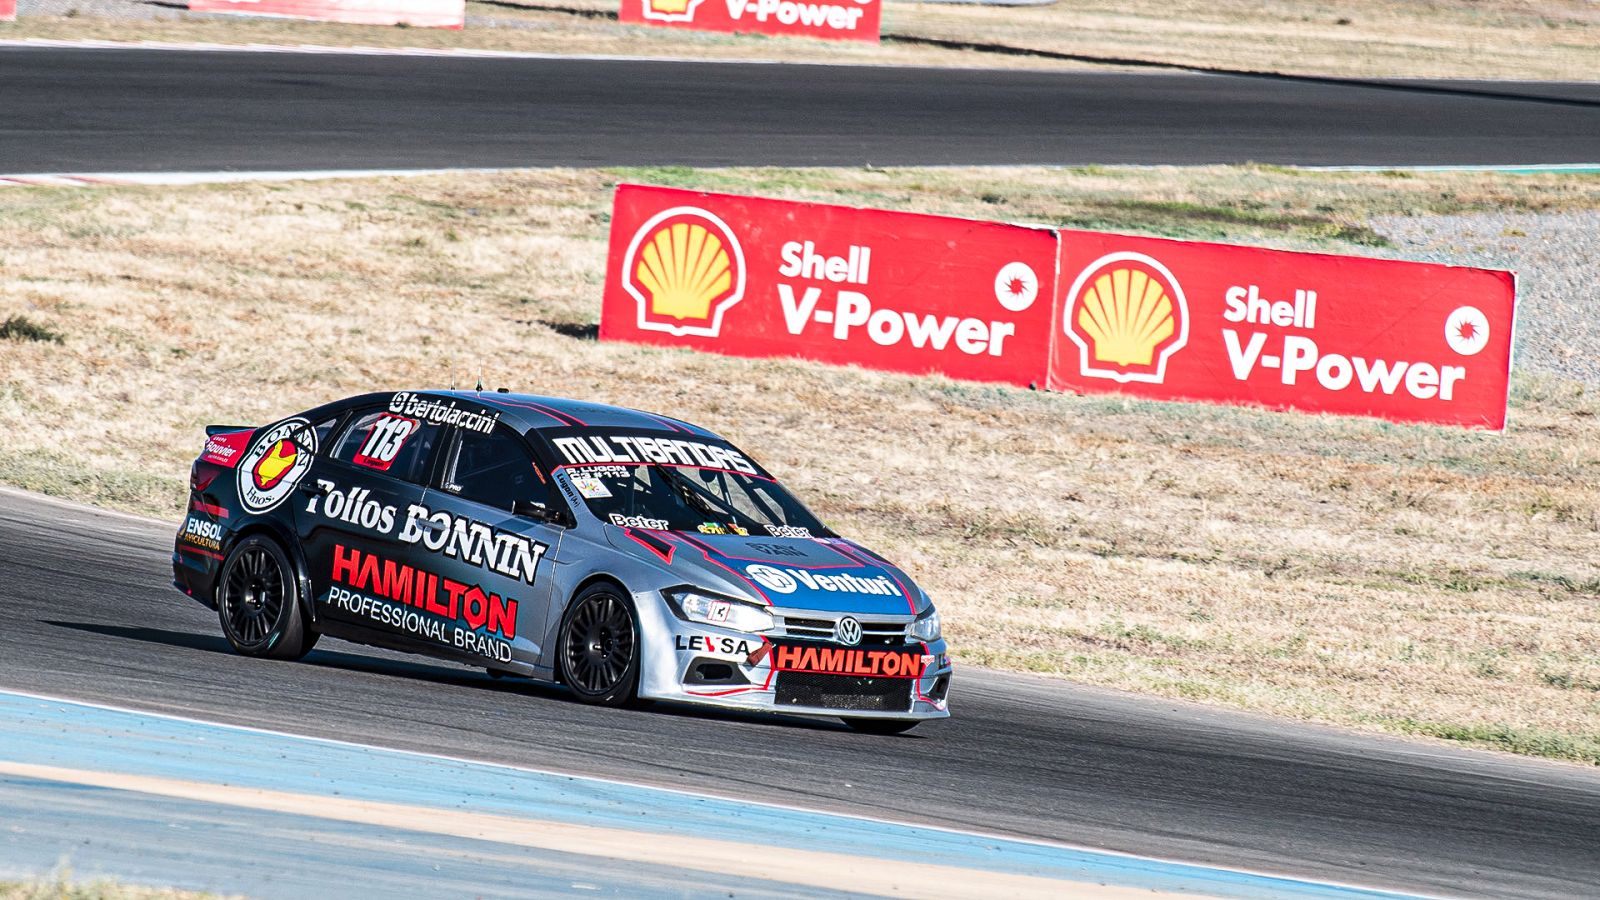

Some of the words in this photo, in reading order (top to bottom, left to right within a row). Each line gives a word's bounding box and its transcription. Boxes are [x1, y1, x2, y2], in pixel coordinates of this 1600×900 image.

[725, 0, 864, 30] V-Power
[778, 240, 871, 285] Shell
[777, 283, 1015, 357] V-Power
[1223, 285, 1318, 329] Shell
[1222, 329, 1466, 401] V-Power
[404, 393, 500, 435] bertolaccini
[361, 416, 412, 462] 113
[552, 436, 758, 475] MULTIBANDAS
[186, 517, 222, 541] ENSOL
[399, 504, 547, 583] BONNIN
[332, 544, 518, 639] HAMILTON
[786, 568, 902, 597] Venturi
[327, 586, 450, 643] PROFESSIONAL
[454, 628, 512, 663] BRAND
[776, 645, 921, 676] HAMILTON
